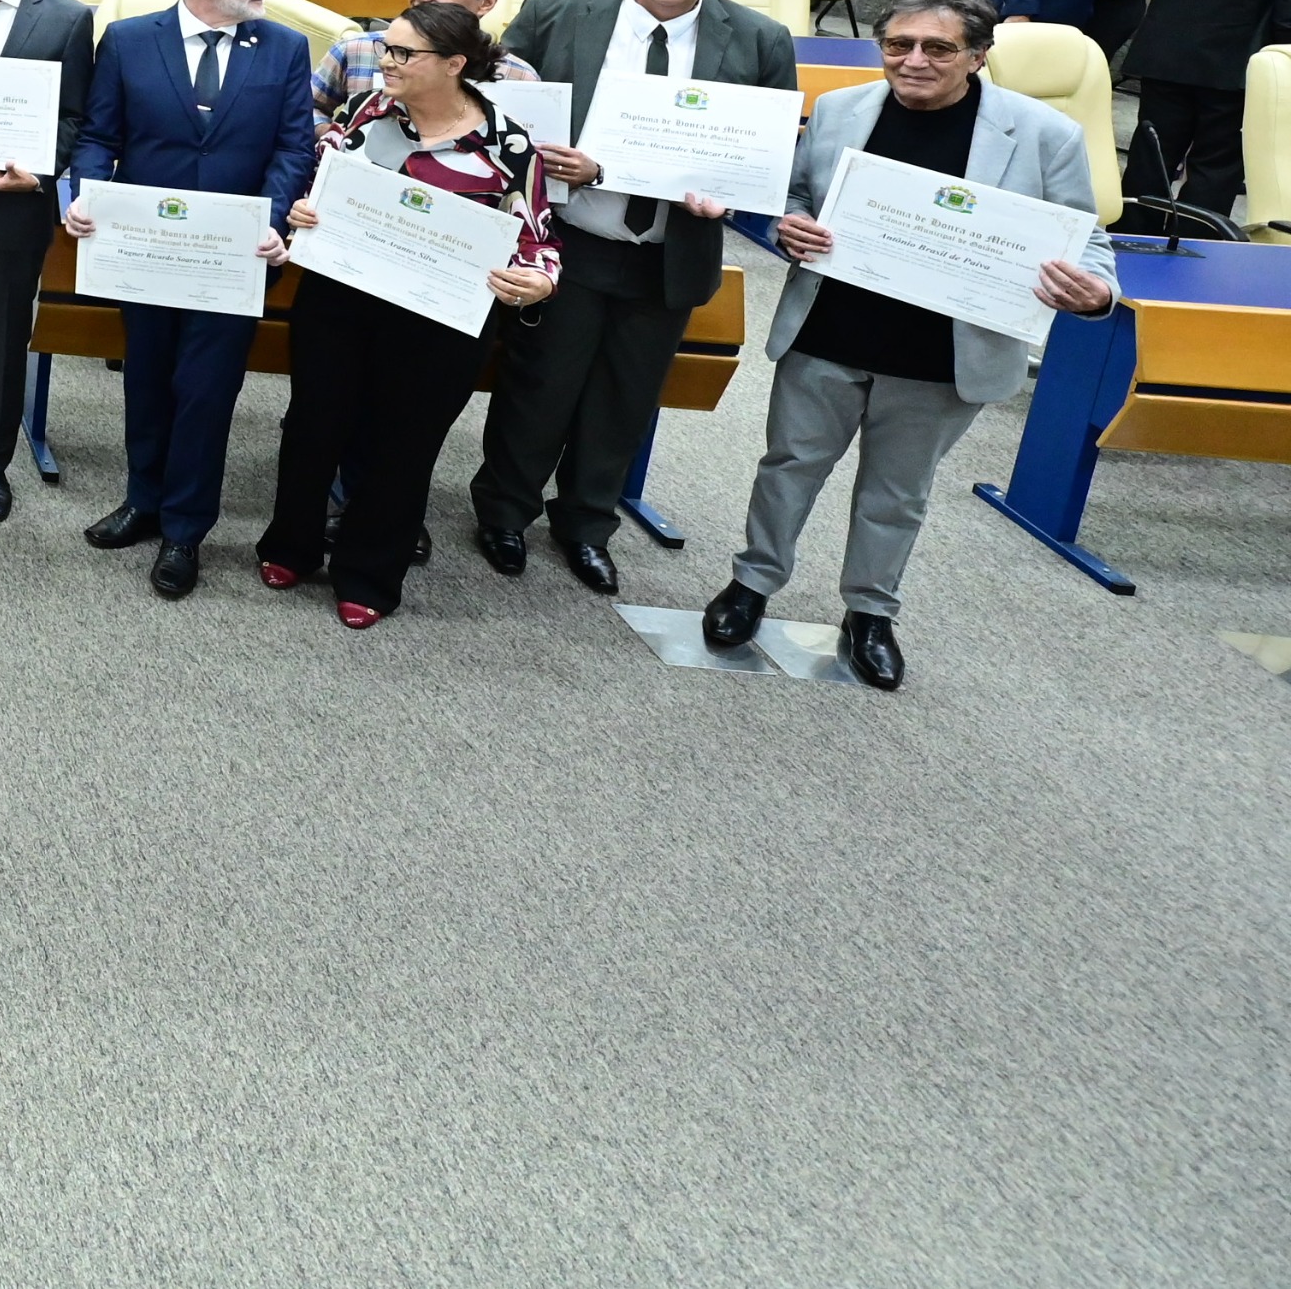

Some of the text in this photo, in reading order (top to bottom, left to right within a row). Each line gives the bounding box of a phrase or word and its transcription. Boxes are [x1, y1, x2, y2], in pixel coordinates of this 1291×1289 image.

[347, 197, 383, 216] Diploma
[398, 215, 425, 232] Honra
[441, 232, 473, 251] Mérito
[867, 198, 913, 220] Diploma
[931, 217, 966, 235] Honra
[985, 233, 1027, 253] Mérito
[363, 230, 438, 264] Nilton Arantes Silva
[918, 243, 947, 259] Brasil
[963, 254, 992, 271] Paiva
